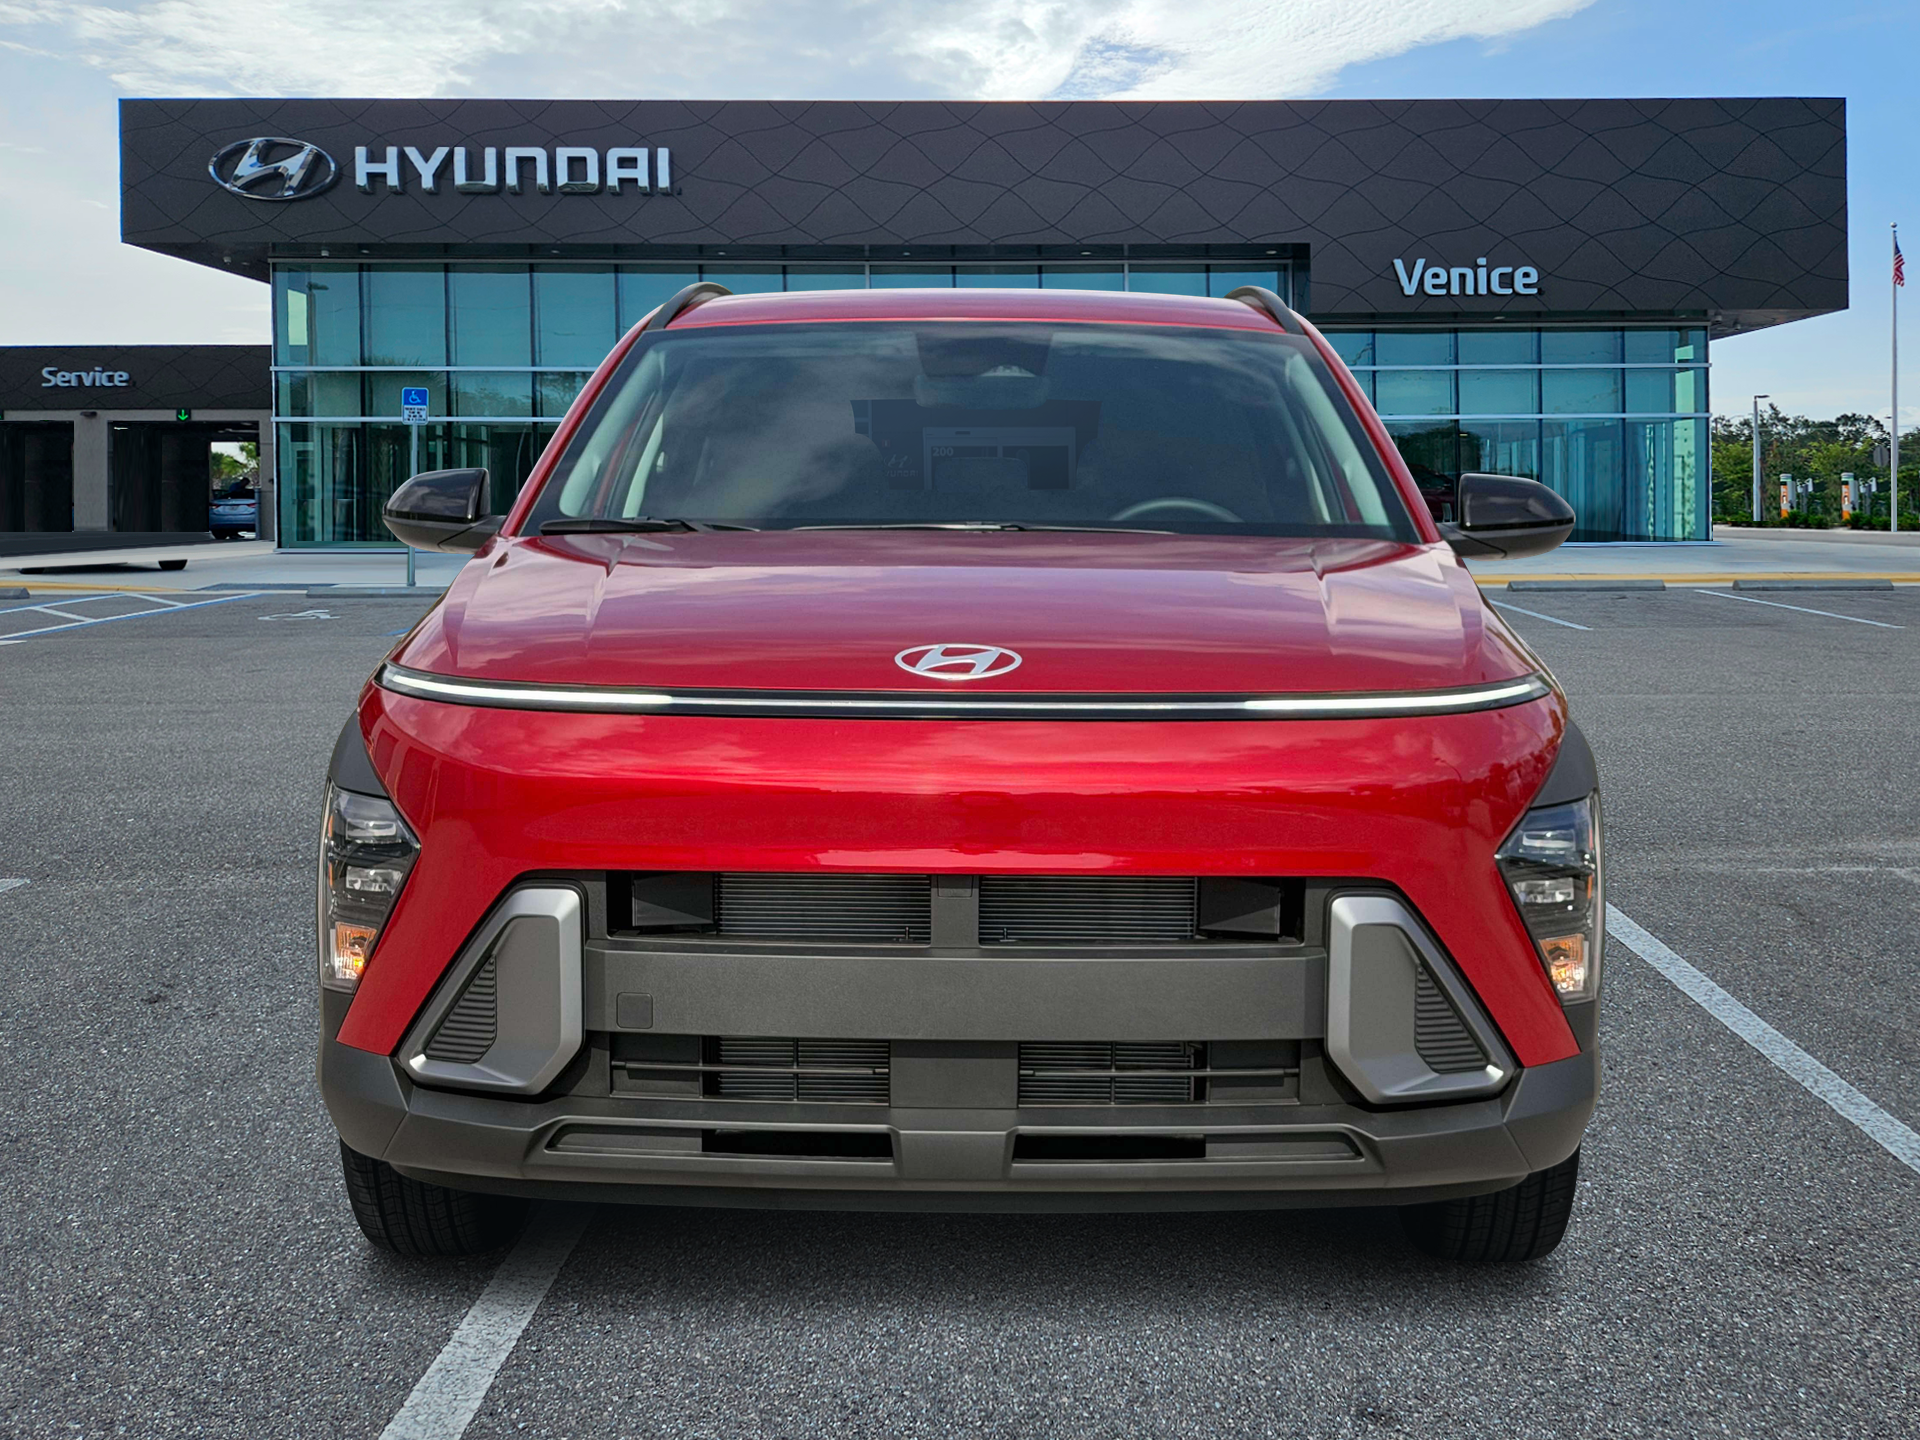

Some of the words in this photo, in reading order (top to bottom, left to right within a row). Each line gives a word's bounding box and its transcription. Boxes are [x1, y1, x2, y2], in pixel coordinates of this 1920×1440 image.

[354, 146, 670, 194] HYUNDAI
[1393, 257, 1539, 296] Venice
[41, 366, 130, 387] Service
[932, 446, 954, 457] 200
